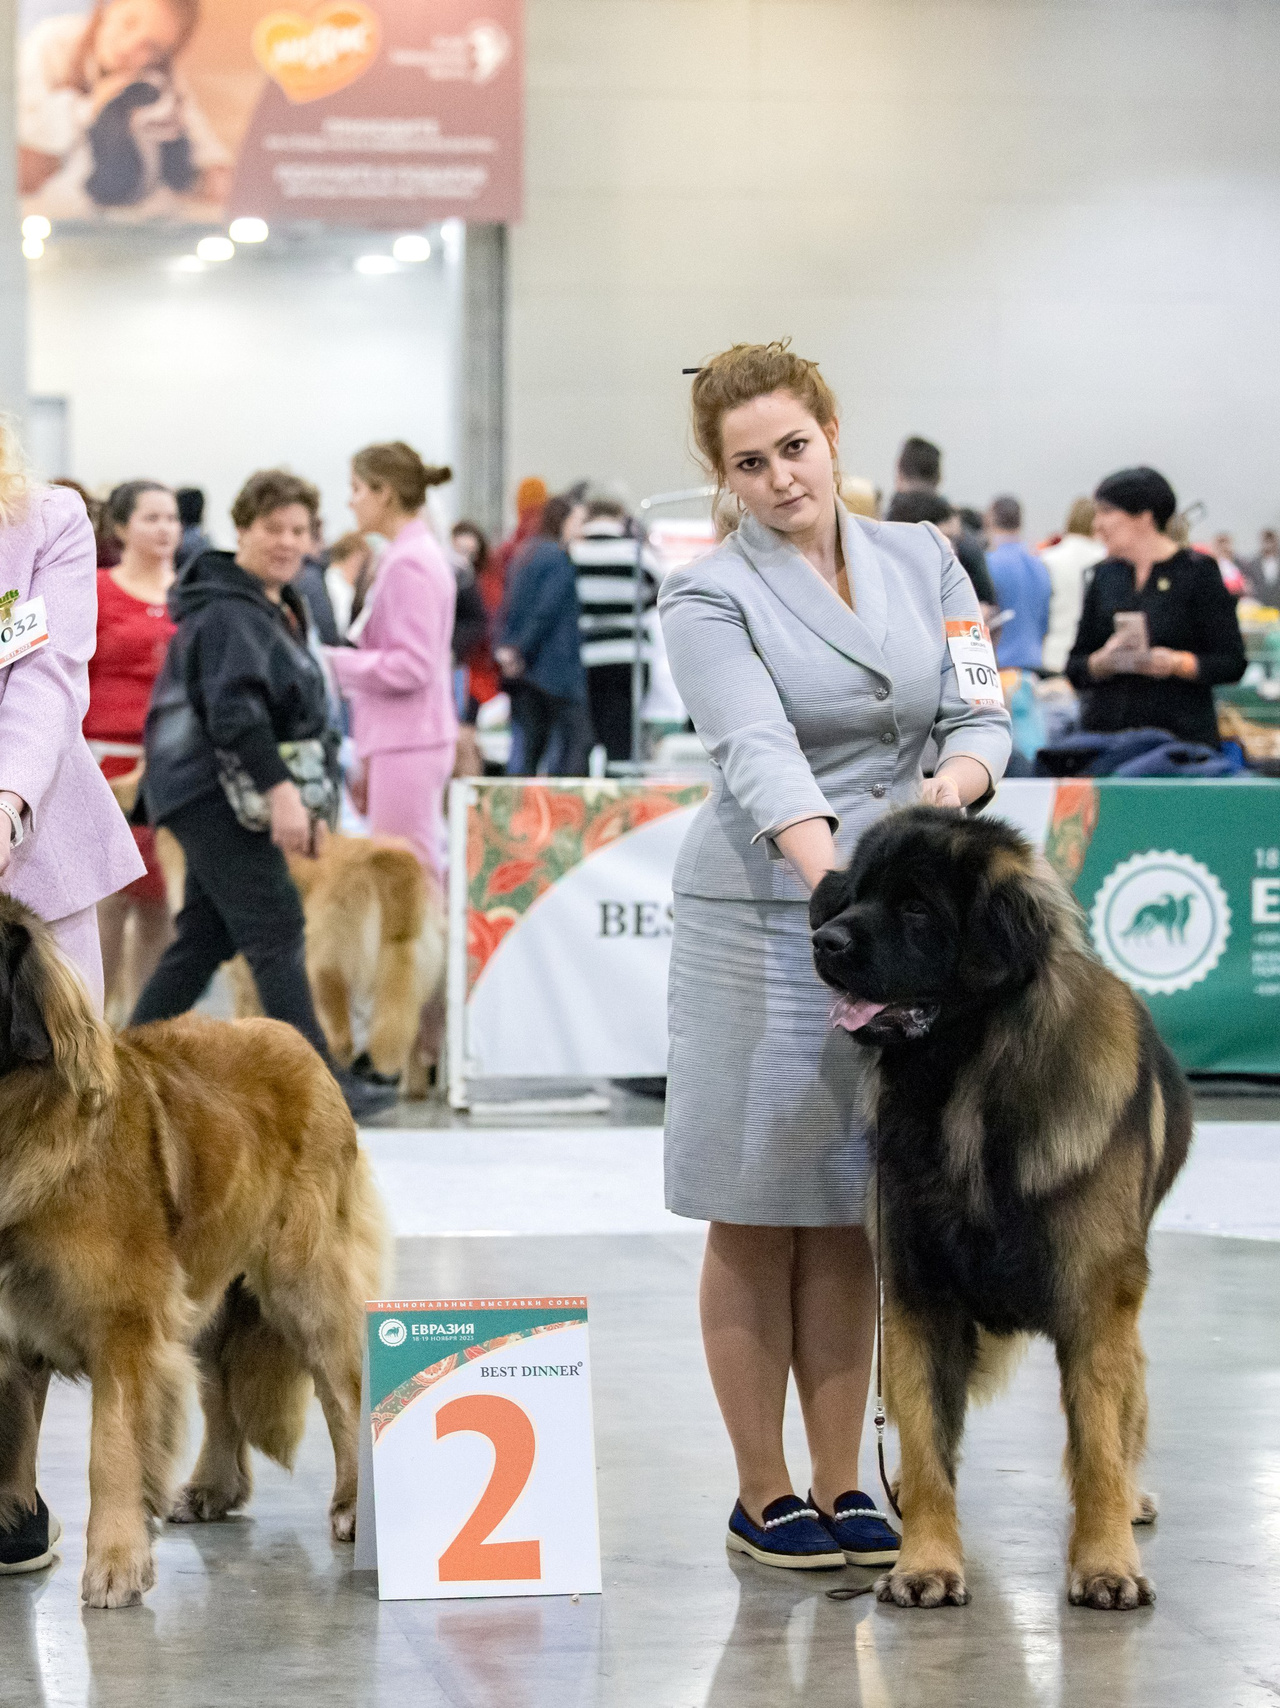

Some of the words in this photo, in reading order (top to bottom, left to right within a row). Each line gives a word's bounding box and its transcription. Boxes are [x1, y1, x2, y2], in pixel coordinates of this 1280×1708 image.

[378, 1301, 474, 1309] НАЦИОНАЛЬНЫЕ
[411, 1323, 475, 1336] ЕВРАЗИЯ
[480, 1366, 518, 1378] BEST
[435, 1394, 542, 1582] 2
